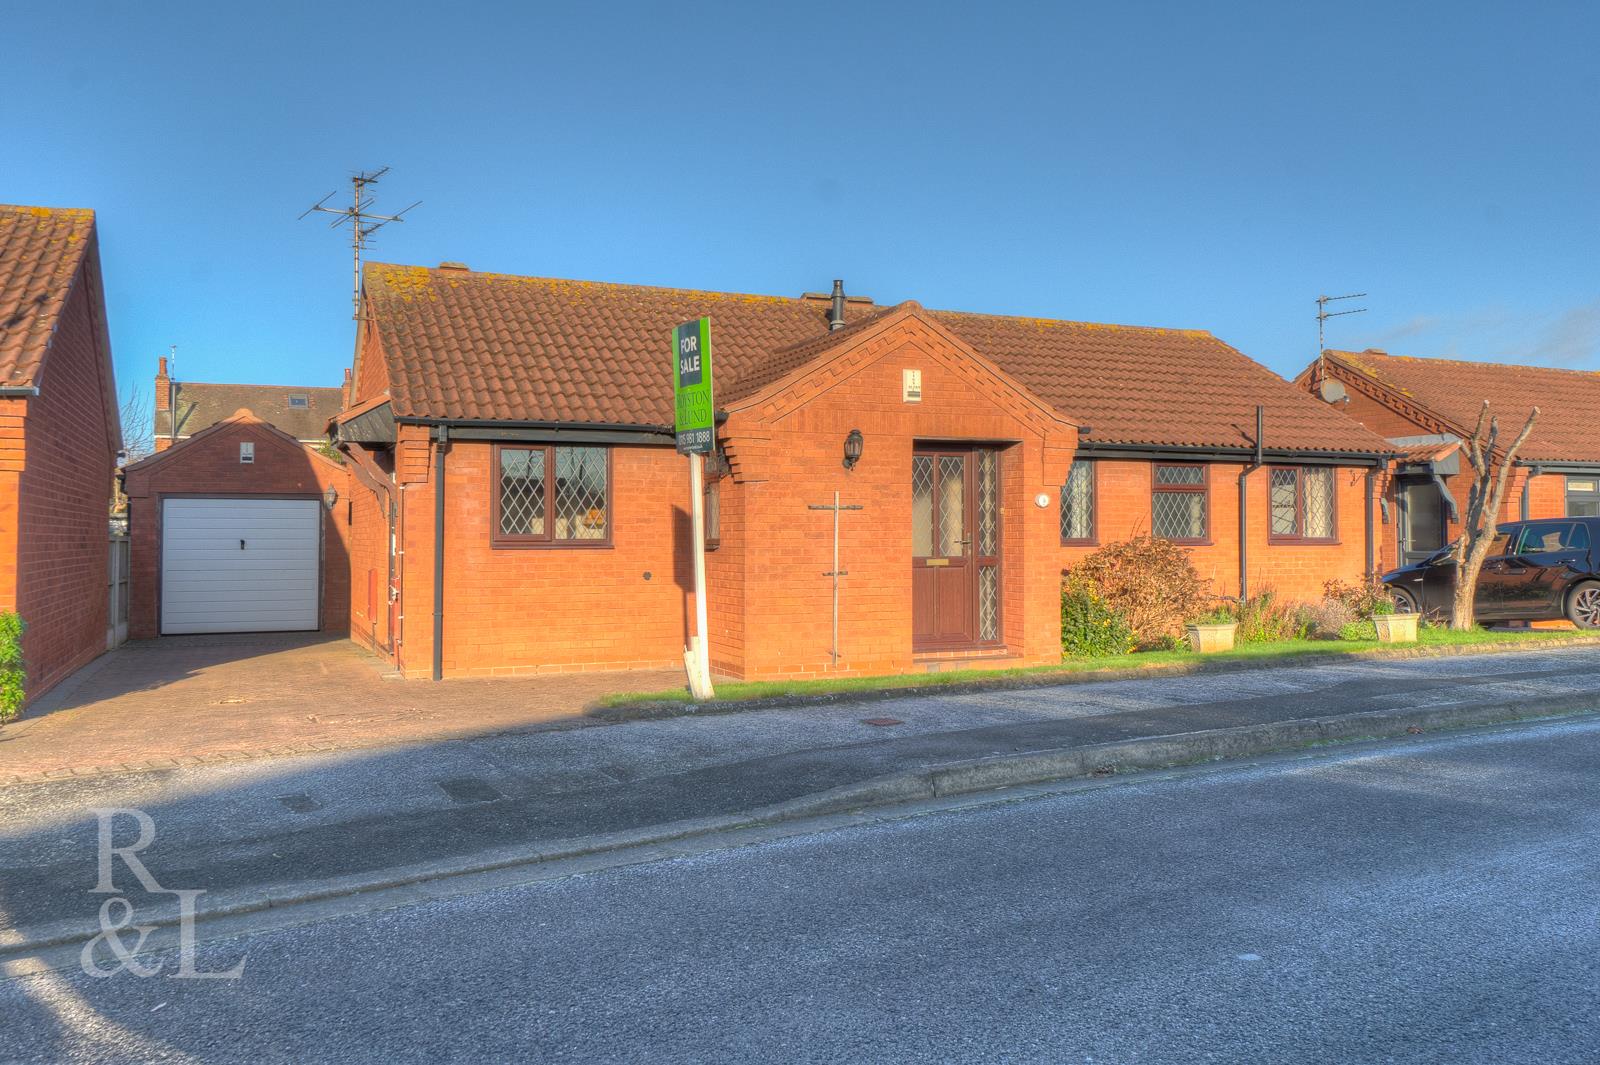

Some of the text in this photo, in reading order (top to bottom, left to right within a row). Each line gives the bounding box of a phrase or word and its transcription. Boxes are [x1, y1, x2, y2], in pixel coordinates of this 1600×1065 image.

[680, 336, 697, 354] FOR
[680, 355, 700, 375] SALE
[696, 430, 711, 443] 1888
